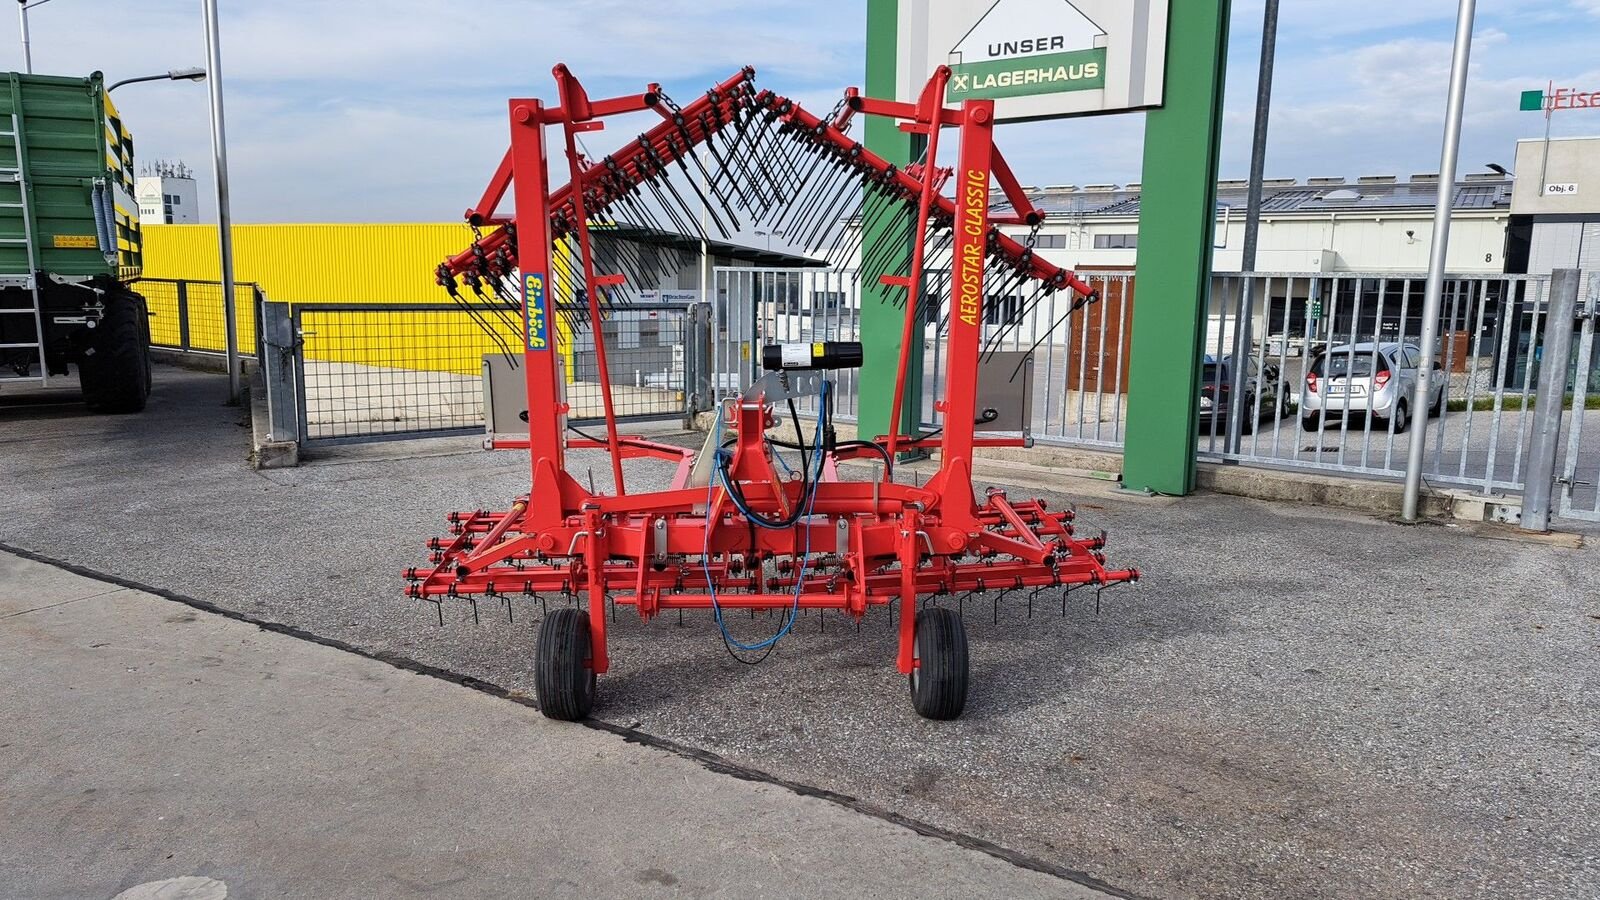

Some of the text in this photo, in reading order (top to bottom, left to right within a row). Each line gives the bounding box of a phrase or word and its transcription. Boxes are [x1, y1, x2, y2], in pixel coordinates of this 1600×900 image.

[988, 35, 1064, 57] UNSER
[972, 62, 1099, 90] LAGERHAUS
[1548, 184, 1575, 193] Obj. 6
[959, 169, 986, 326] AEROSTAR-CLASSIC
[1485, 252, 1493, 264] 8
[526, 275, 546, 348] Einböck
